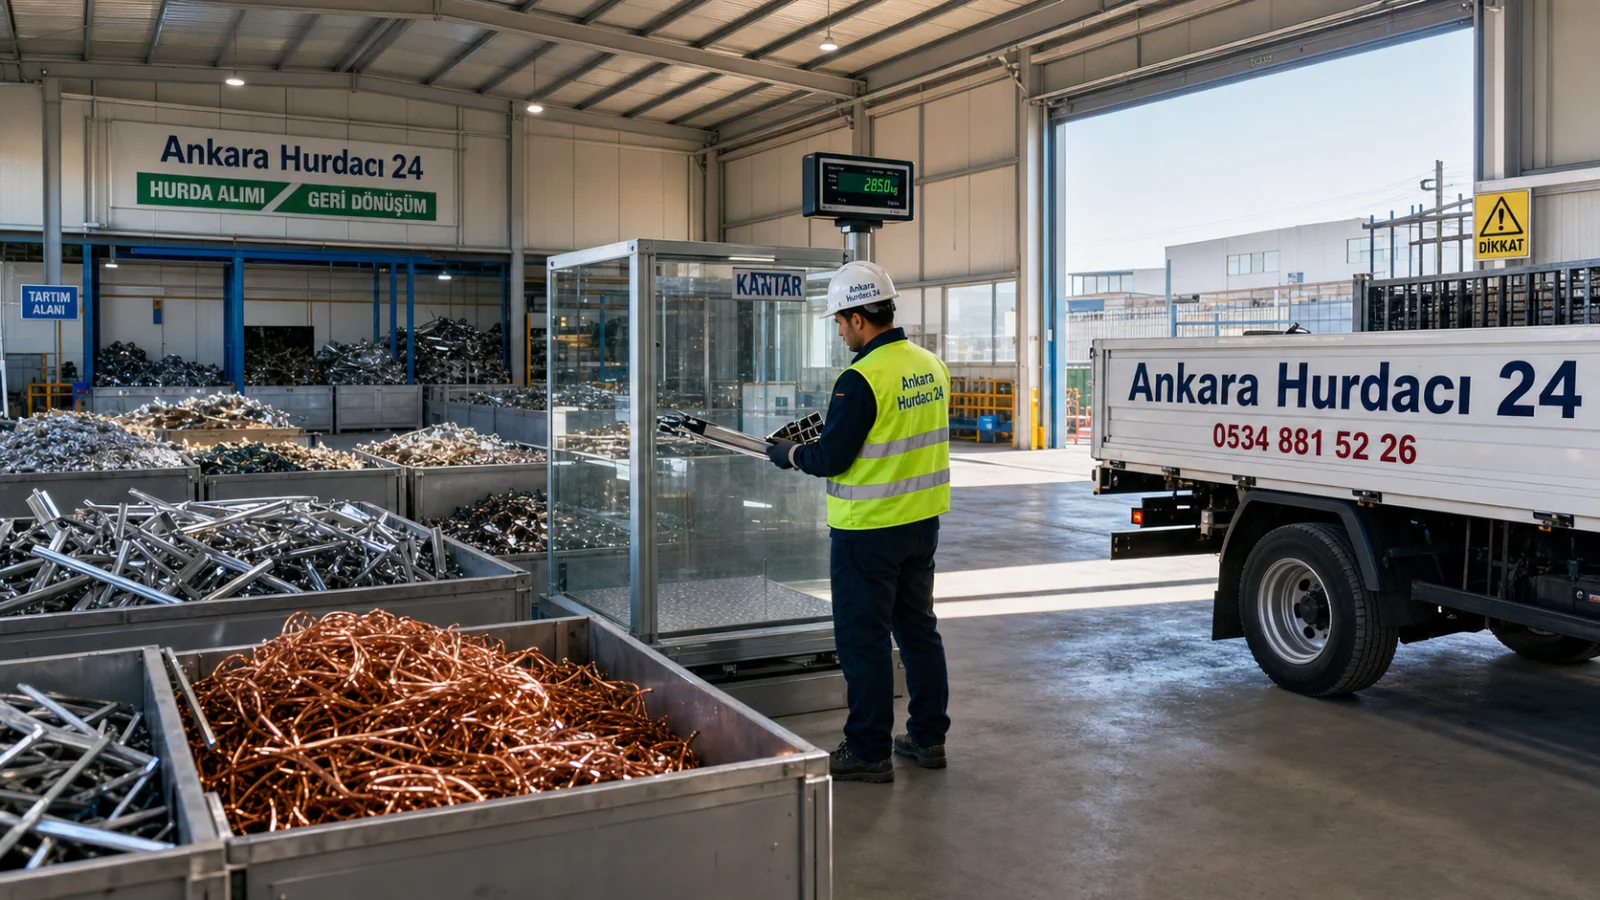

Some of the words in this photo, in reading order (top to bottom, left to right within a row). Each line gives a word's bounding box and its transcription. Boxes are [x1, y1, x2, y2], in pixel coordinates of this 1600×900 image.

[160, 135, 269, 169] Ankara
[280, 144, 384, 178] Hurdacı
[391, 153, 424, 180] 24
[150, 181, 213, 202] HURDA
[217, 184, 265, 204] ALIMI
[308, 190, 346, 209] GERİ
[351, 192, 427, 217] DÖNÜŞÜM
[1479, 238, 1524, 254] DİKKAT
[736, 271, 802, 297] KANTAR
[849, 282, 875, 294] Ankara
[28, 291, 71, 303] TARTIM
[32, 304, 65, 315] ALANI
[901, 373, 934, 391] Ankara
[1128, 362, 1259, 407] Ankara
[1277, 361, 1471, 415] Hurdacı
[1497, 360, 1583, 419] 24
[897, 391, 933, 411] Hurdacı
[933, 385, 944, 400] 24
[1213, 422, 1270, 452] 0534
[1278, 426, 1323, 456] 881
[1335, 430, 1369, 460] 52
[1380, 433, 1417, 465] 26
